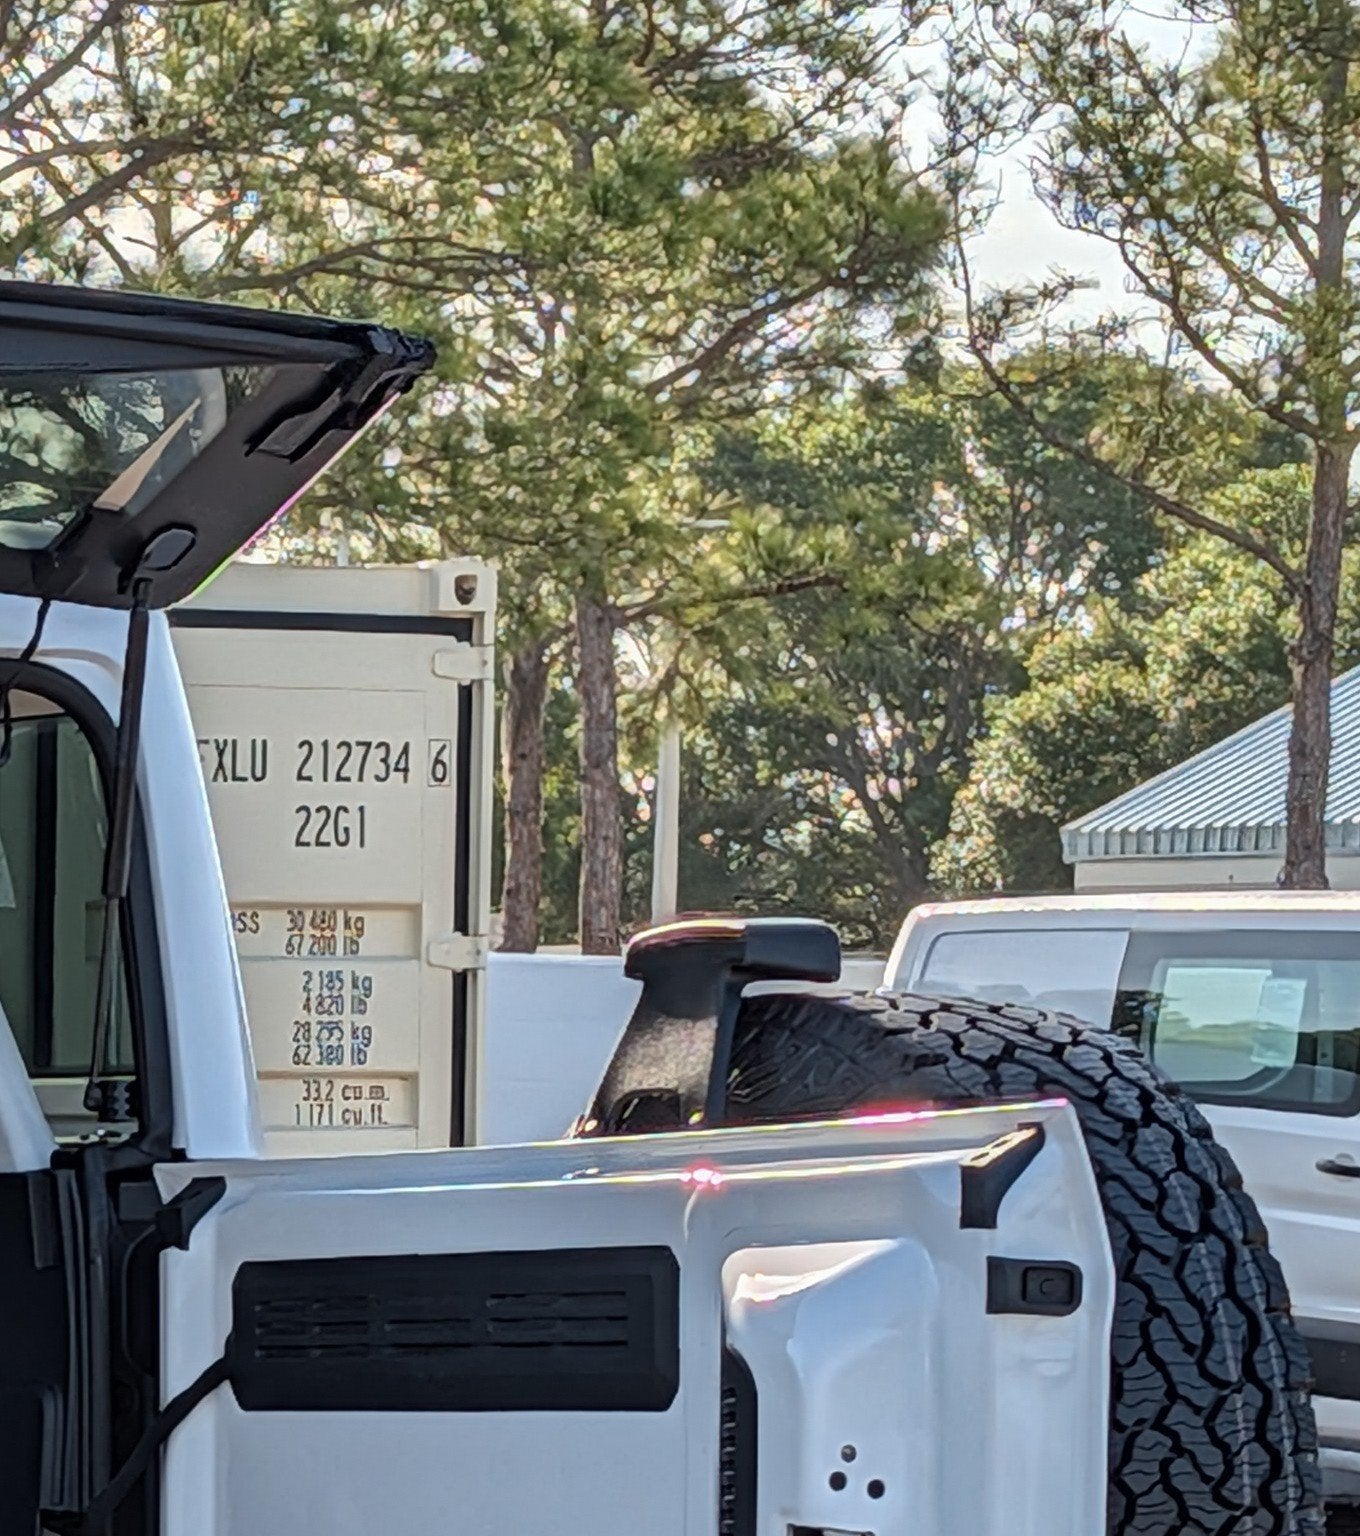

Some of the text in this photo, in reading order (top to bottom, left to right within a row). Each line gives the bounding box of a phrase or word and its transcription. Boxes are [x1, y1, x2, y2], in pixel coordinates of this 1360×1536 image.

[296, 739, 410, 784] 212734
[431, 742, 448, 783] 6
[294, 805, 366, 849] 22G1
[344, 910, 365, 938] kg
[344, 934, 360, 956] lb
[351, 970, 372, 998] kg
[351, 994, 368, 1015] lb
[351, 1021, 372, 1047] kg
[292, 1044, 312, 1066] 62
[351, 1044, 367, 1066] lb
